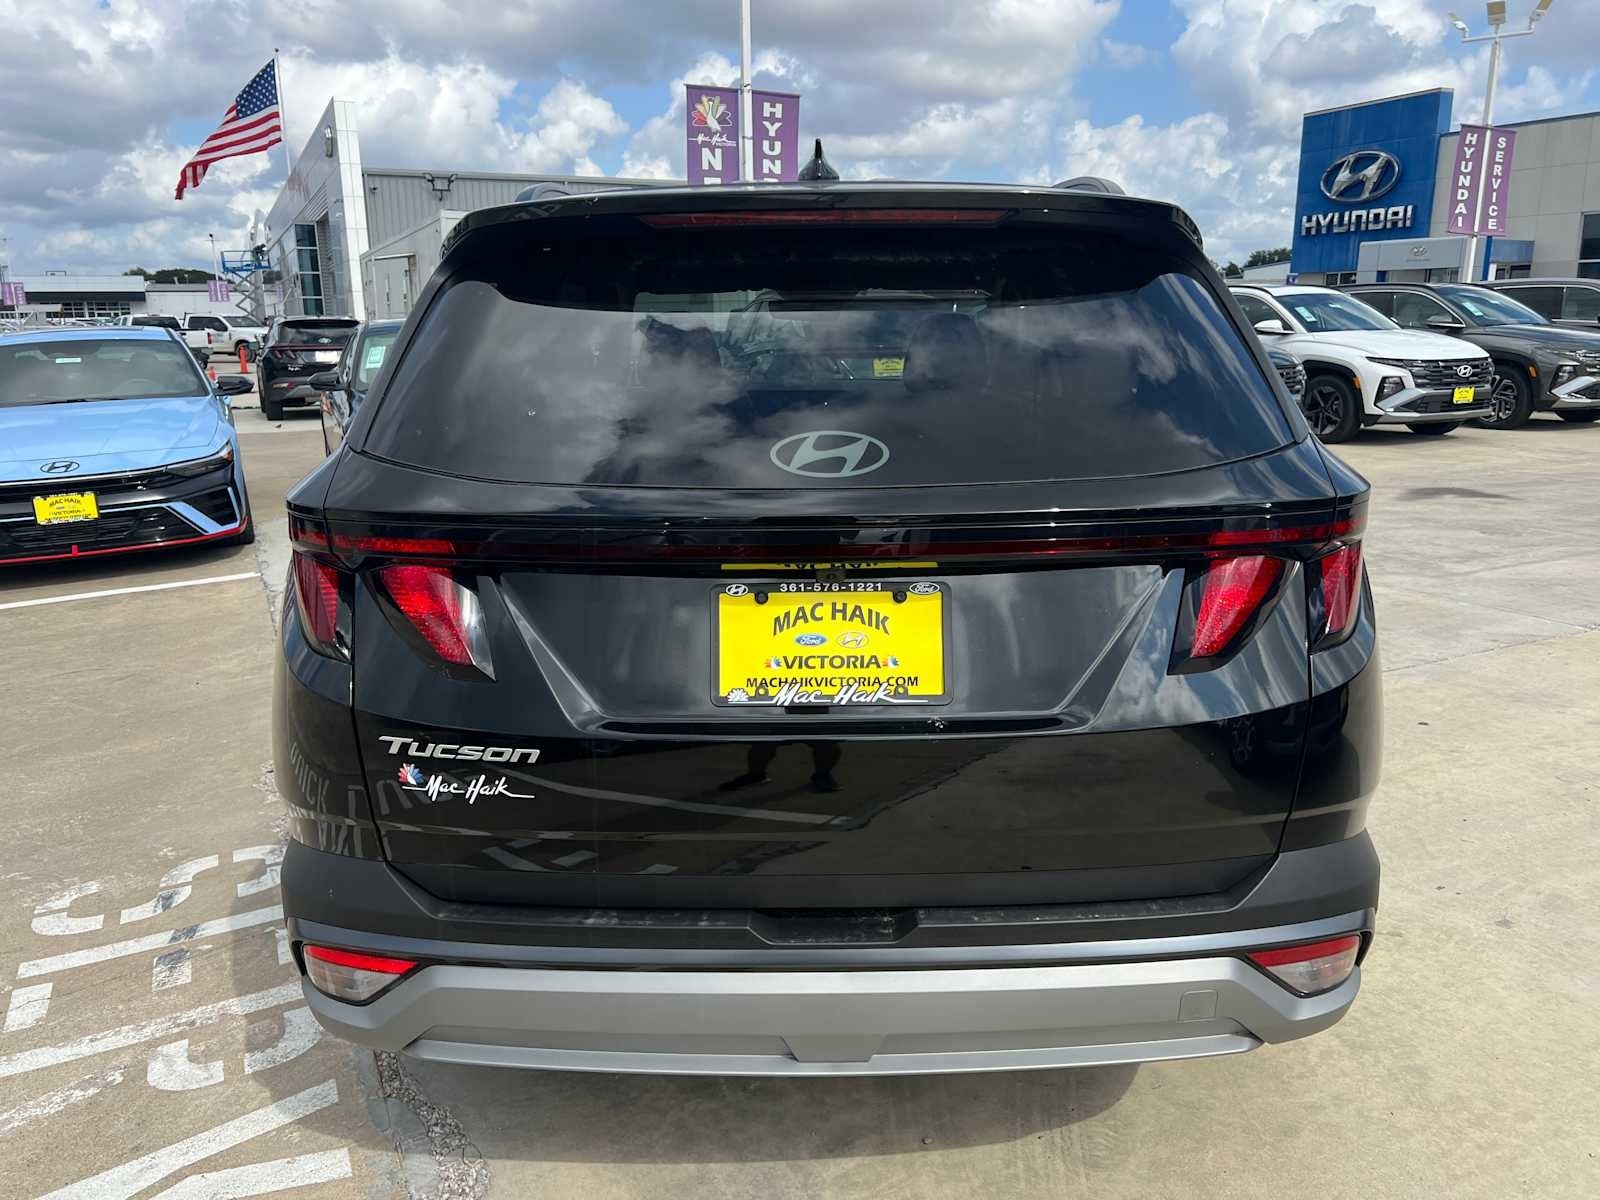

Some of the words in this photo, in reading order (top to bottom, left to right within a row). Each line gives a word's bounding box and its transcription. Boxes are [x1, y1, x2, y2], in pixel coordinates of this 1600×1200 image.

[763, 102, 783, 182] HYUN
[1454, 133, 1478, 228] HYUNDAI
[1487, 136, 1507, 230] SERVICE
[1301, 205, 1414, 236] HYUNDAI
[779, 582, 883, 593] 361-576-1221
[773, 602, 824, 636] MAC
[831, 601, 890, 636] HAIK
[797, 634, 824, 647] Ford
[782, 655, 882, 670] VICTORIA
[746, 676, 919, 688] MACHAIKVICTORIA.COM
[771, 683, 830, 706] Mac
[832, 682, 898, 706] Haik
[424, 774, 464, 802] Mac
[466, 774, 514, 804] Haik
